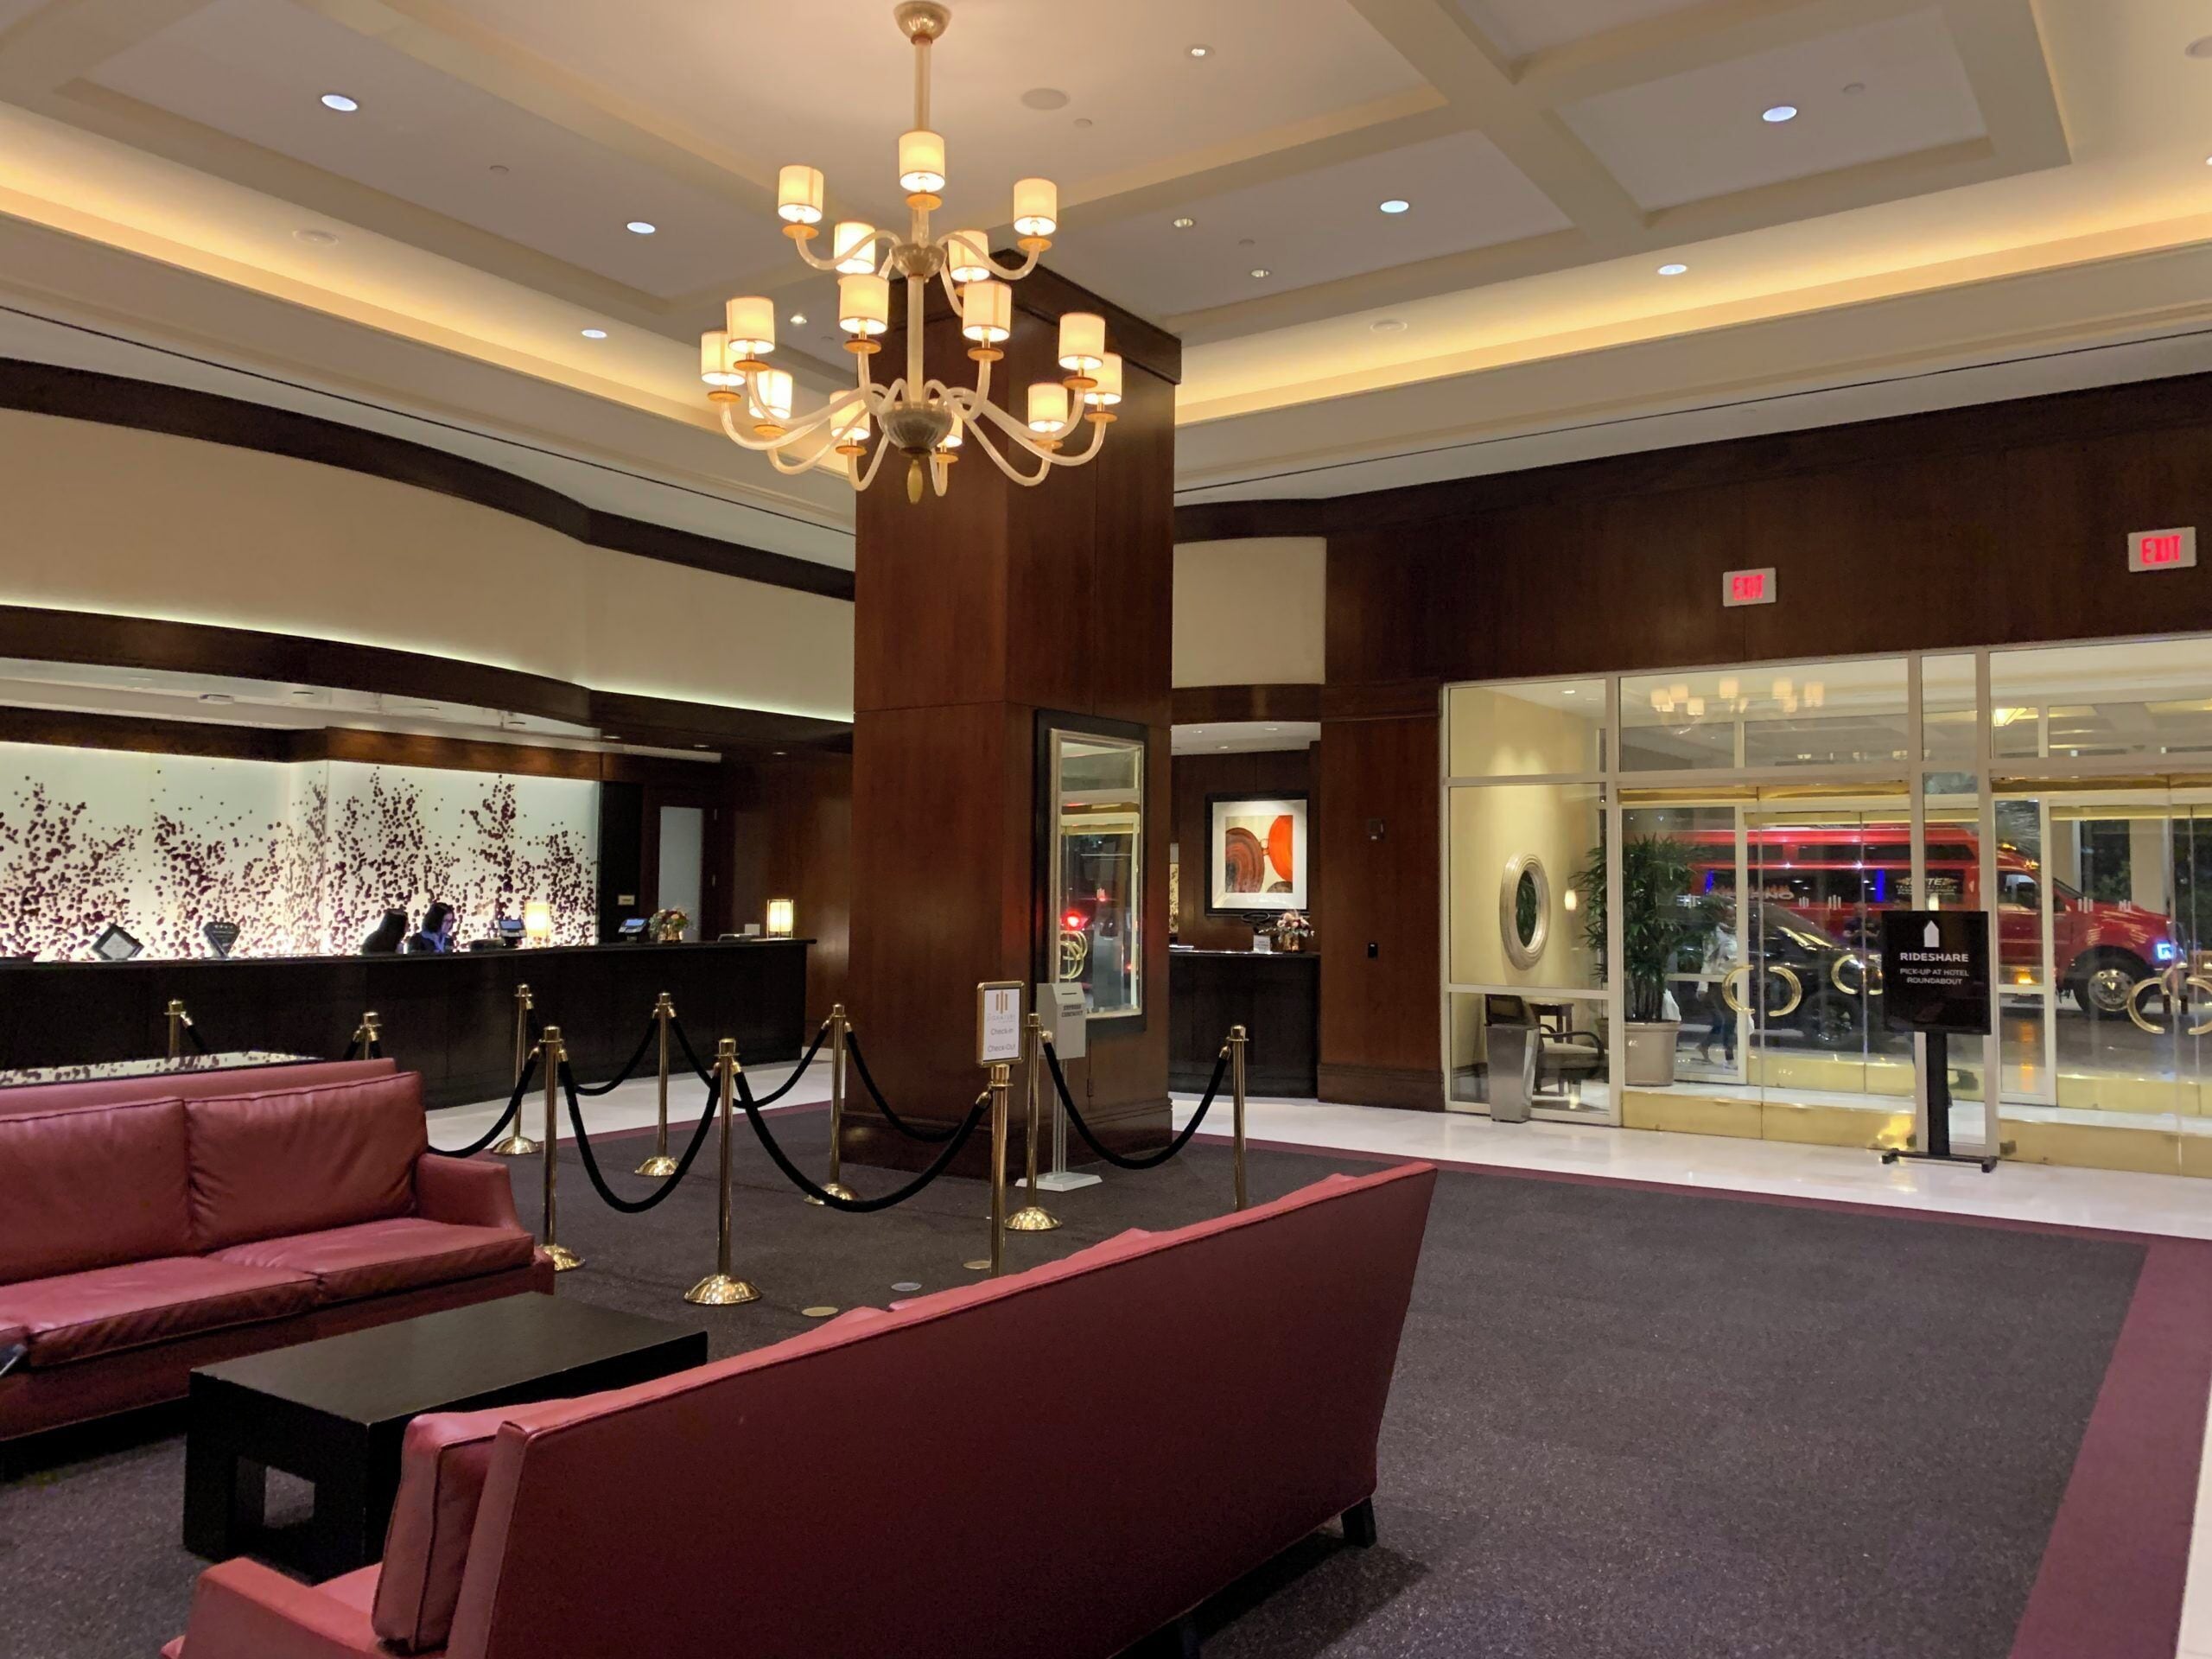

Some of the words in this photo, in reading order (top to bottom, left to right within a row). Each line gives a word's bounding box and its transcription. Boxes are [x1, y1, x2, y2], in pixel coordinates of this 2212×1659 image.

[2140, 535, 2182, 565] EXIT
[1732, 574, 1764, 601] EXIT
[1900, 952, 1969, 963] RIDESHARE
[1906, 976, 1963, 985] ROUNDABOUT
